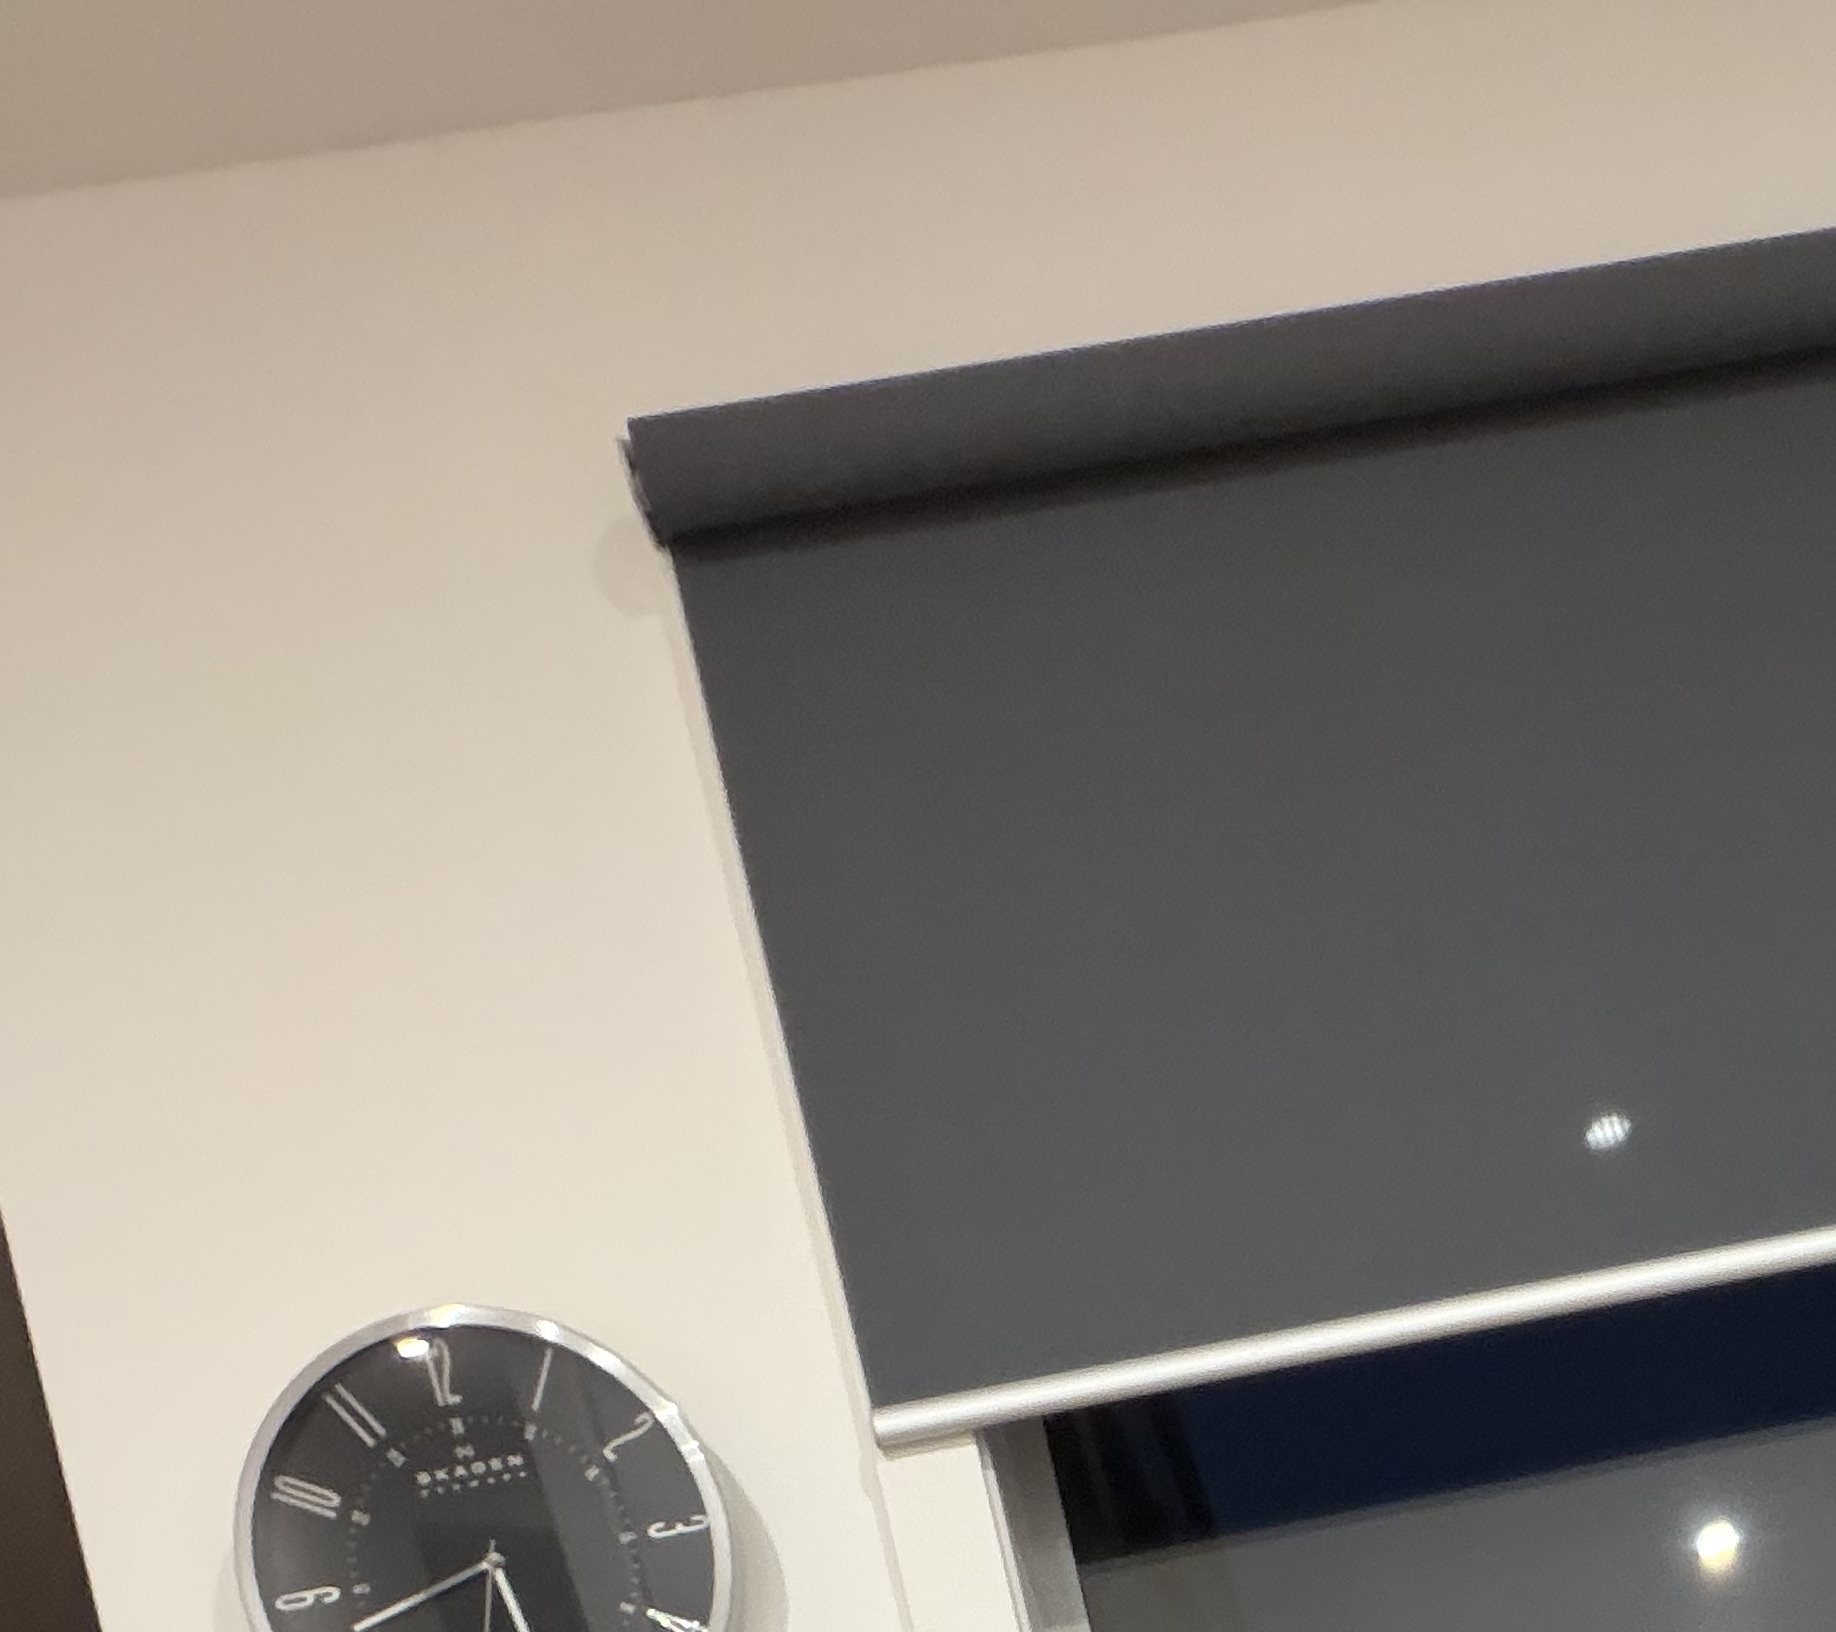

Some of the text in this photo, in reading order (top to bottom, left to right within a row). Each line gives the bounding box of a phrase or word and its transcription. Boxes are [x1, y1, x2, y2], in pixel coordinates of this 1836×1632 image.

[323, 1382, 388, 1448] 11
[602, 1412, 655, 1461] 2
[269, 1474, 342, 1521] 10
[646, 1514, 711, 1541] 3
[274, 1585, 342, 1613] 9
